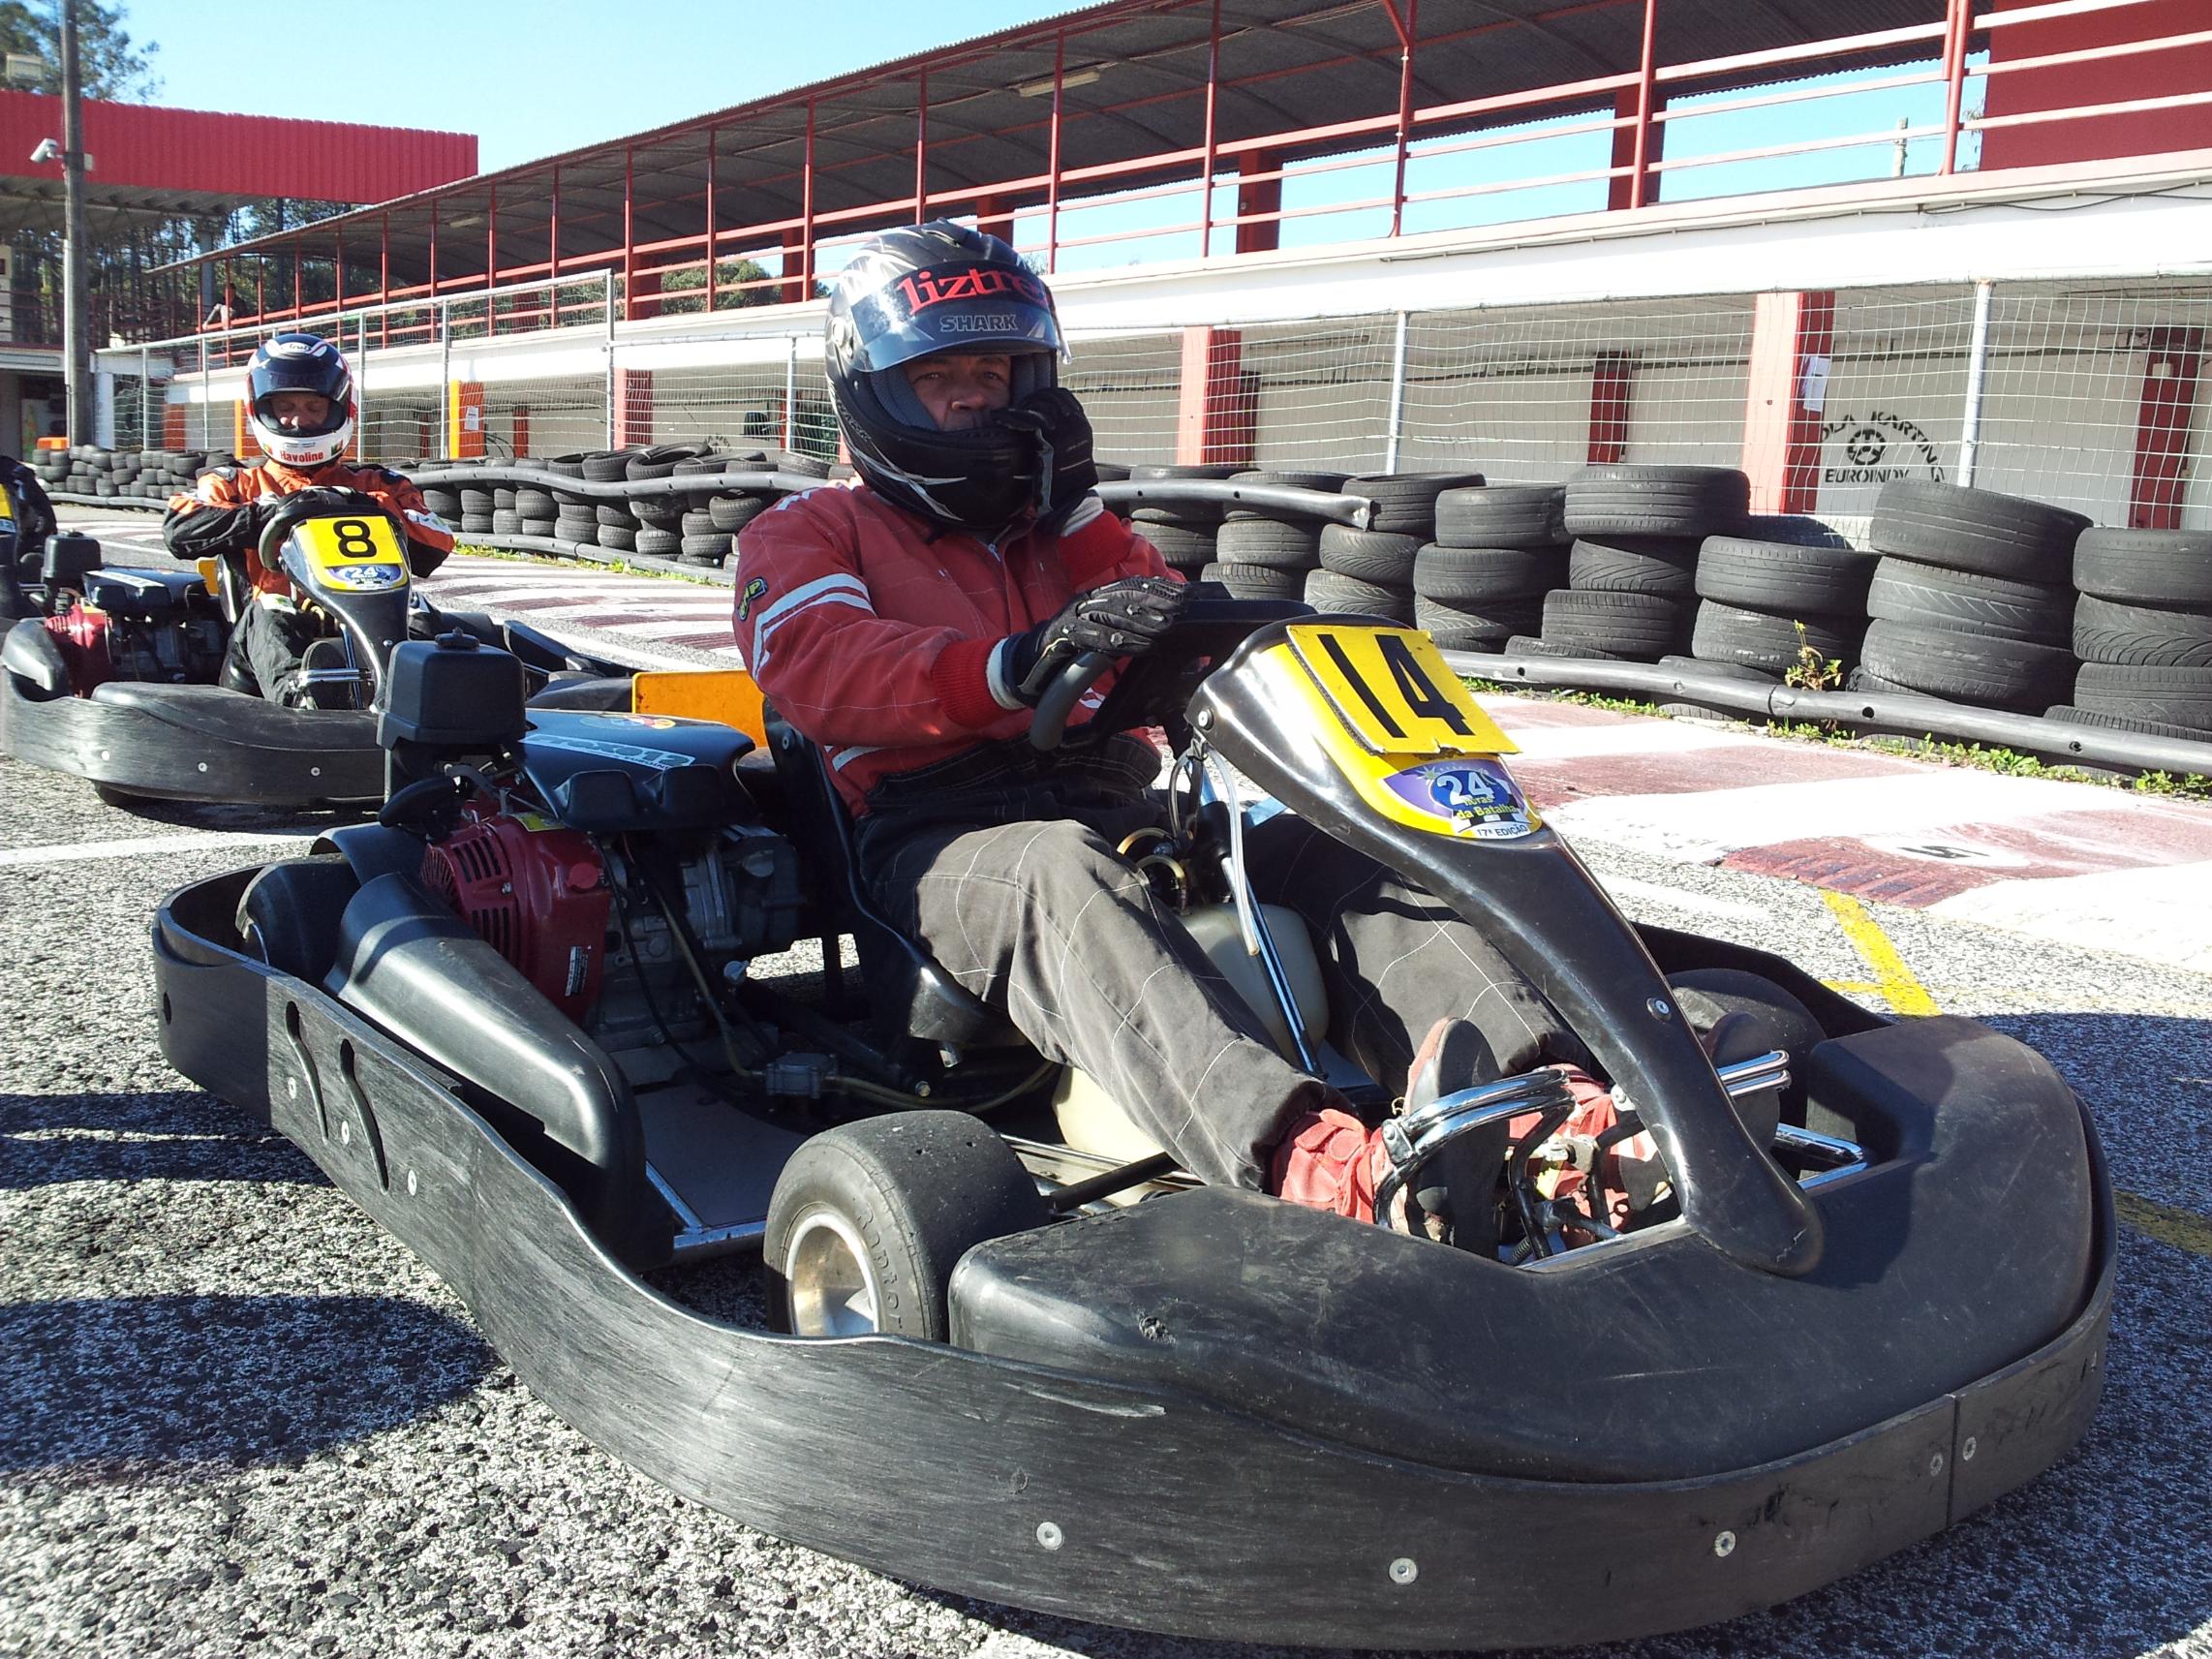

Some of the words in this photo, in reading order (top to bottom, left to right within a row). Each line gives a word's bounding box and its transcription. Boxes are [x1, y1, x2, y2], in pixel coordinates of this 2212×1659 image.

[939, 313, 1019, 333] SHARK
[279, 450, 324, 463] Havoline
[332, 519, 378, 559] 8
[1316, 633, 1476, 739] 14
[1436, 771, 1495, 806] 24
[1456, 810, 1474, 820] da
[1475, 804, 1519, 816] Batalha
[1495, 823, 1528, 837] EDIÇÃO
